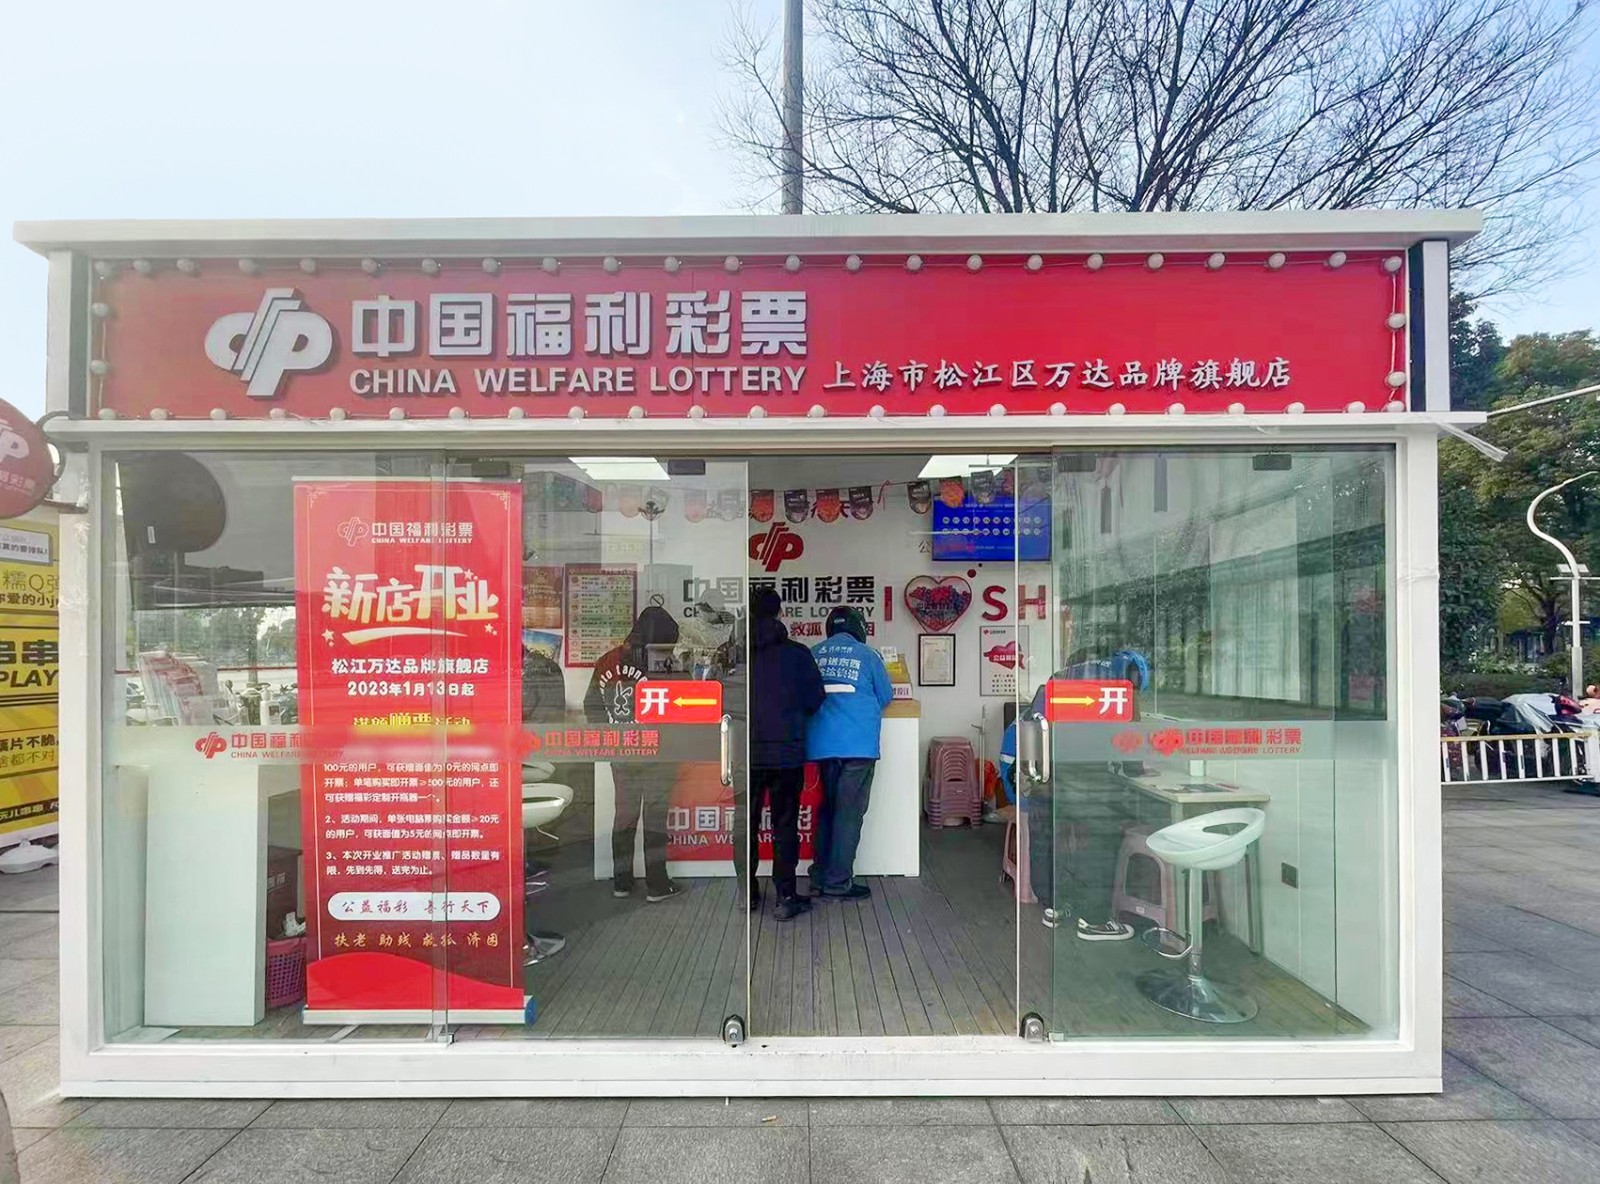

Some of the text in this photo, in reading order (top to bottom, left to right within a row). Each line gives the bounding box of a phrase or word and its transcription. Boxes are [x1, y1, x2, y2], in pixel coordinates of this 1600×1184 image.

[350, 290, 808, 357] 中国福利彩票
[349, 367, 807, 395] CHINA WELFARE LOTTERY
[823, 357, 1292, 392] 上海市松江区万达品牌旗舰店
[371, 521, 473, 538] 中国福利彩票
[321, 564, 500, 624] 新店开业
[331, 658, 489, 674] 松江万达品牌旗舰店
[347, 681, 475, 697] 2023年1月13日起
[640, 688, 670, 716] 开
[1098, 687, 1128, 715] 开
[231, 751, 258, 759] CHINA
[619, 748, 658, 756] LOTTERY
[341, 899, 409, 914] 公益福彩
